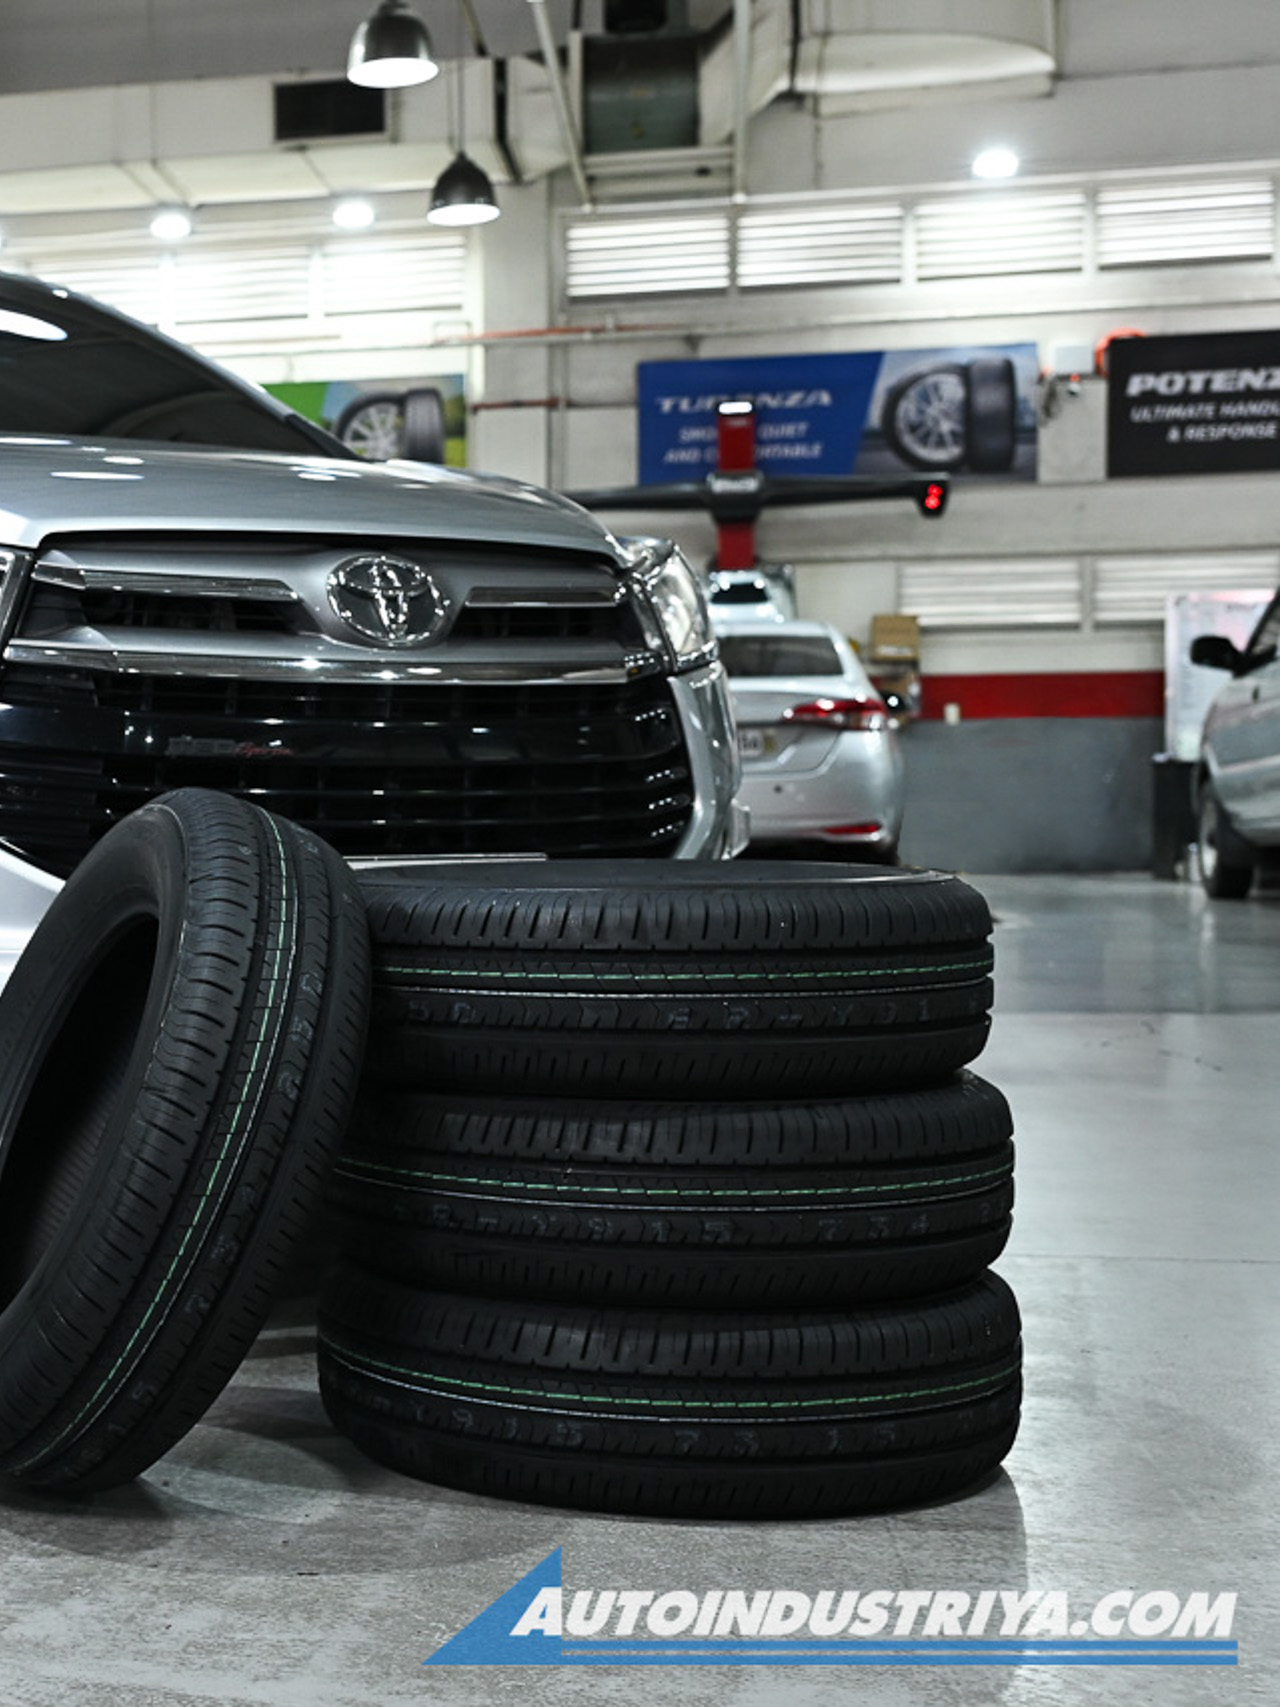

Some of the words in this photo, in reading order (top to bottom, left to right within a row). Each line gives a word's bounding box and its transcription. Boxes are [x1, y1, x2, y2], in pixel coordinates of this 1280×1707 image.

[1130, 402, 1216, 423] ULTIMATE
[757, 421, 810, 440] QUIET
[1183, 420, 1278, 441] RESPONSE
